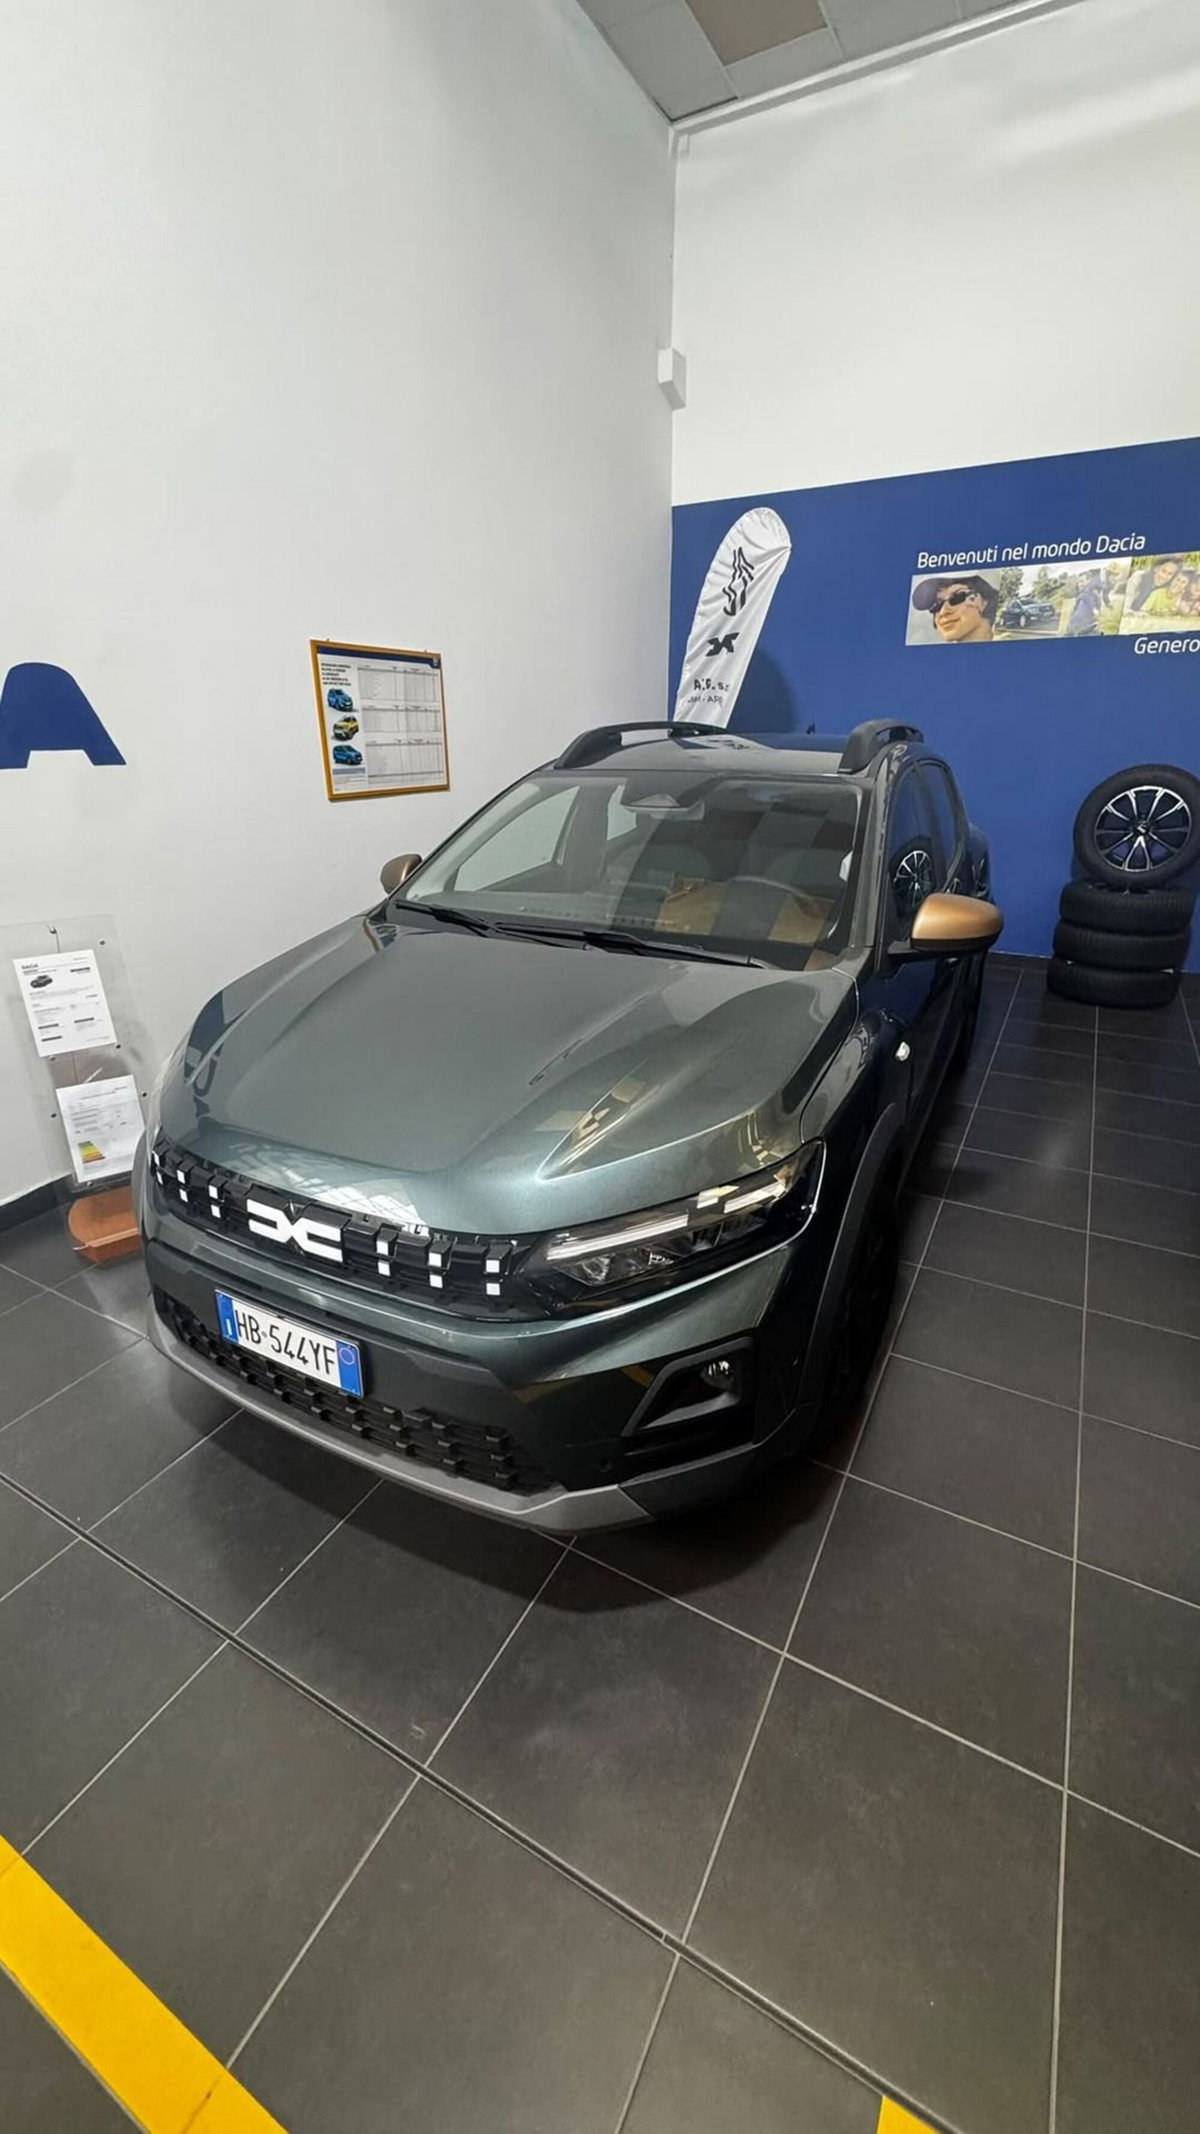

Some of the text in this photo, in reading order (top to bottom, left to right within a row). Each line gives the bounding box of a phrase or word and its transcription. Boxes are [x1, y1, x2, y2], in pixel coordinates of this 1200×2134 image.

[917, 532, 1146, 569] Benvenuti nel mondo Dacia
[1134, 637, 1200, 654] Genero
